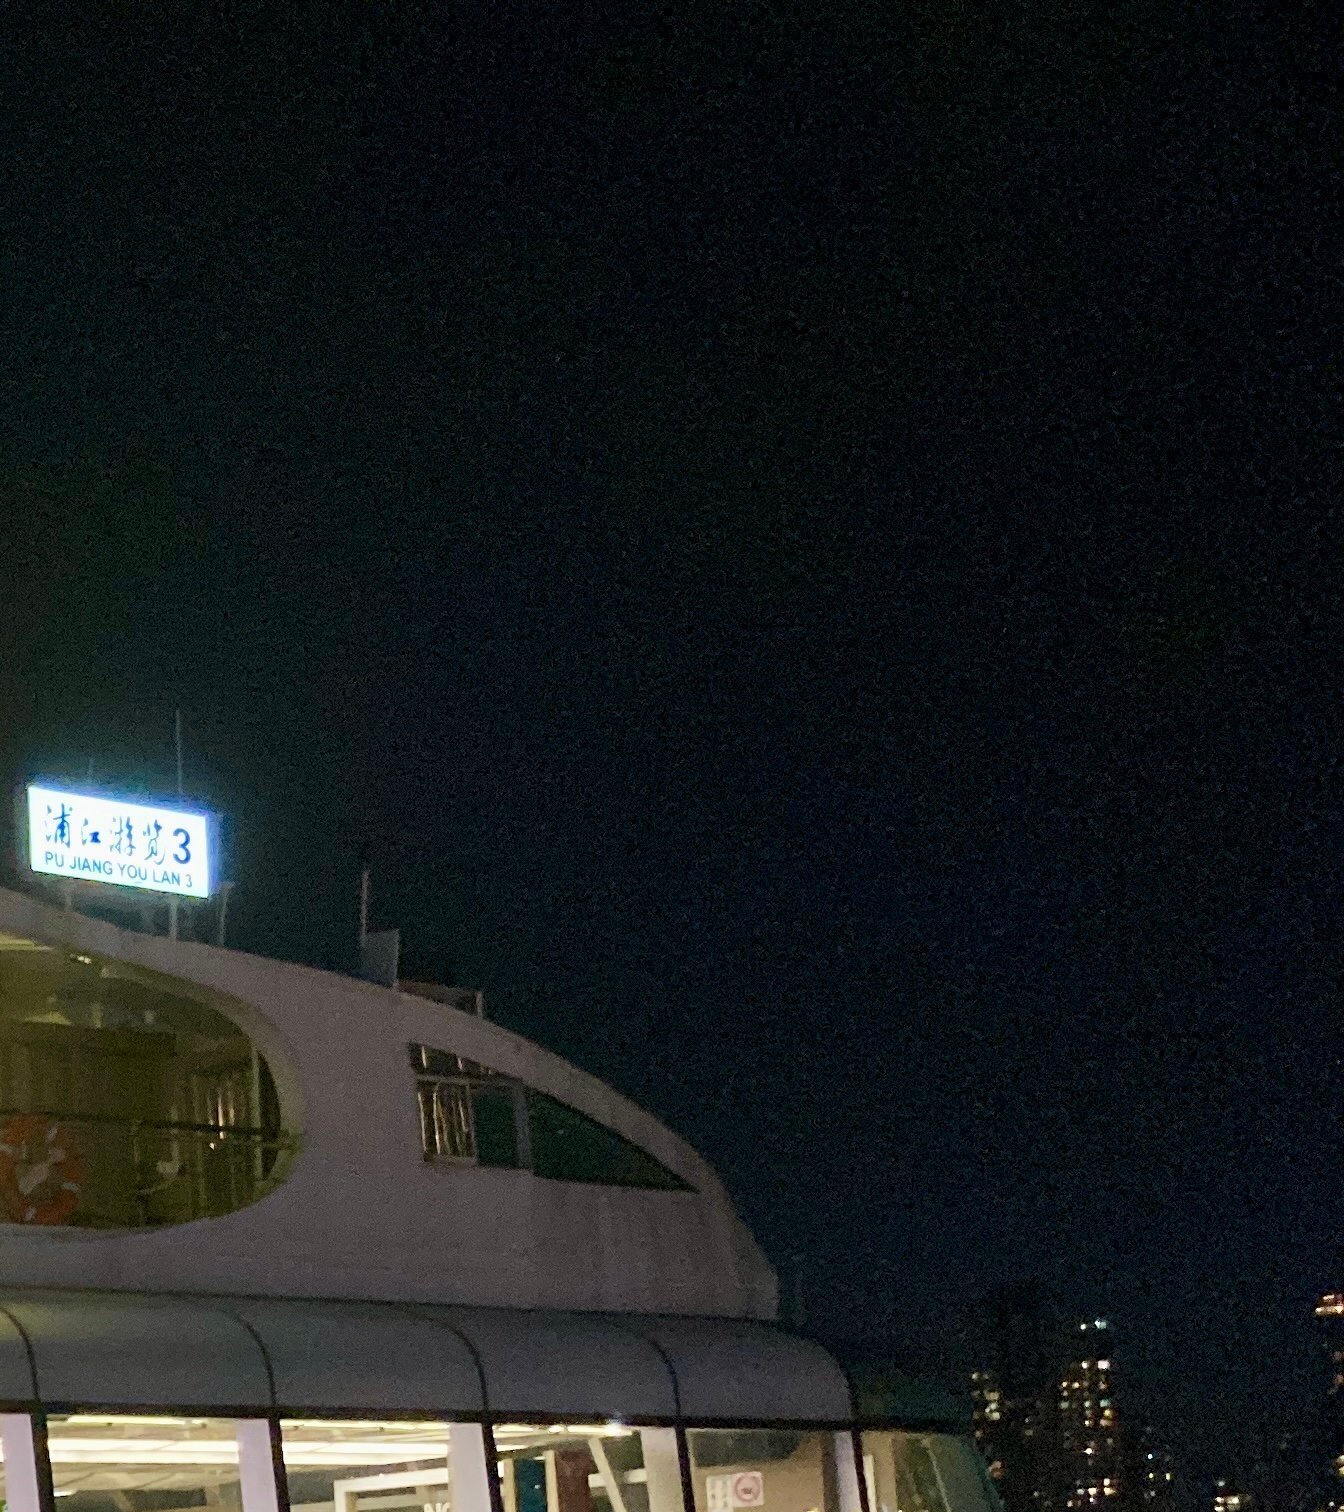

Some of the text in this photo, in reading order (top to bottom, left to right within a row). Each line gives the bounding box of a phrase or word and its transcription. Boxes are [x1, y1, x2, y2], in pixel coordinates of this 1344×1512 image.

[44, 851, 193, 888] PU JIANG YOU LAN 3
